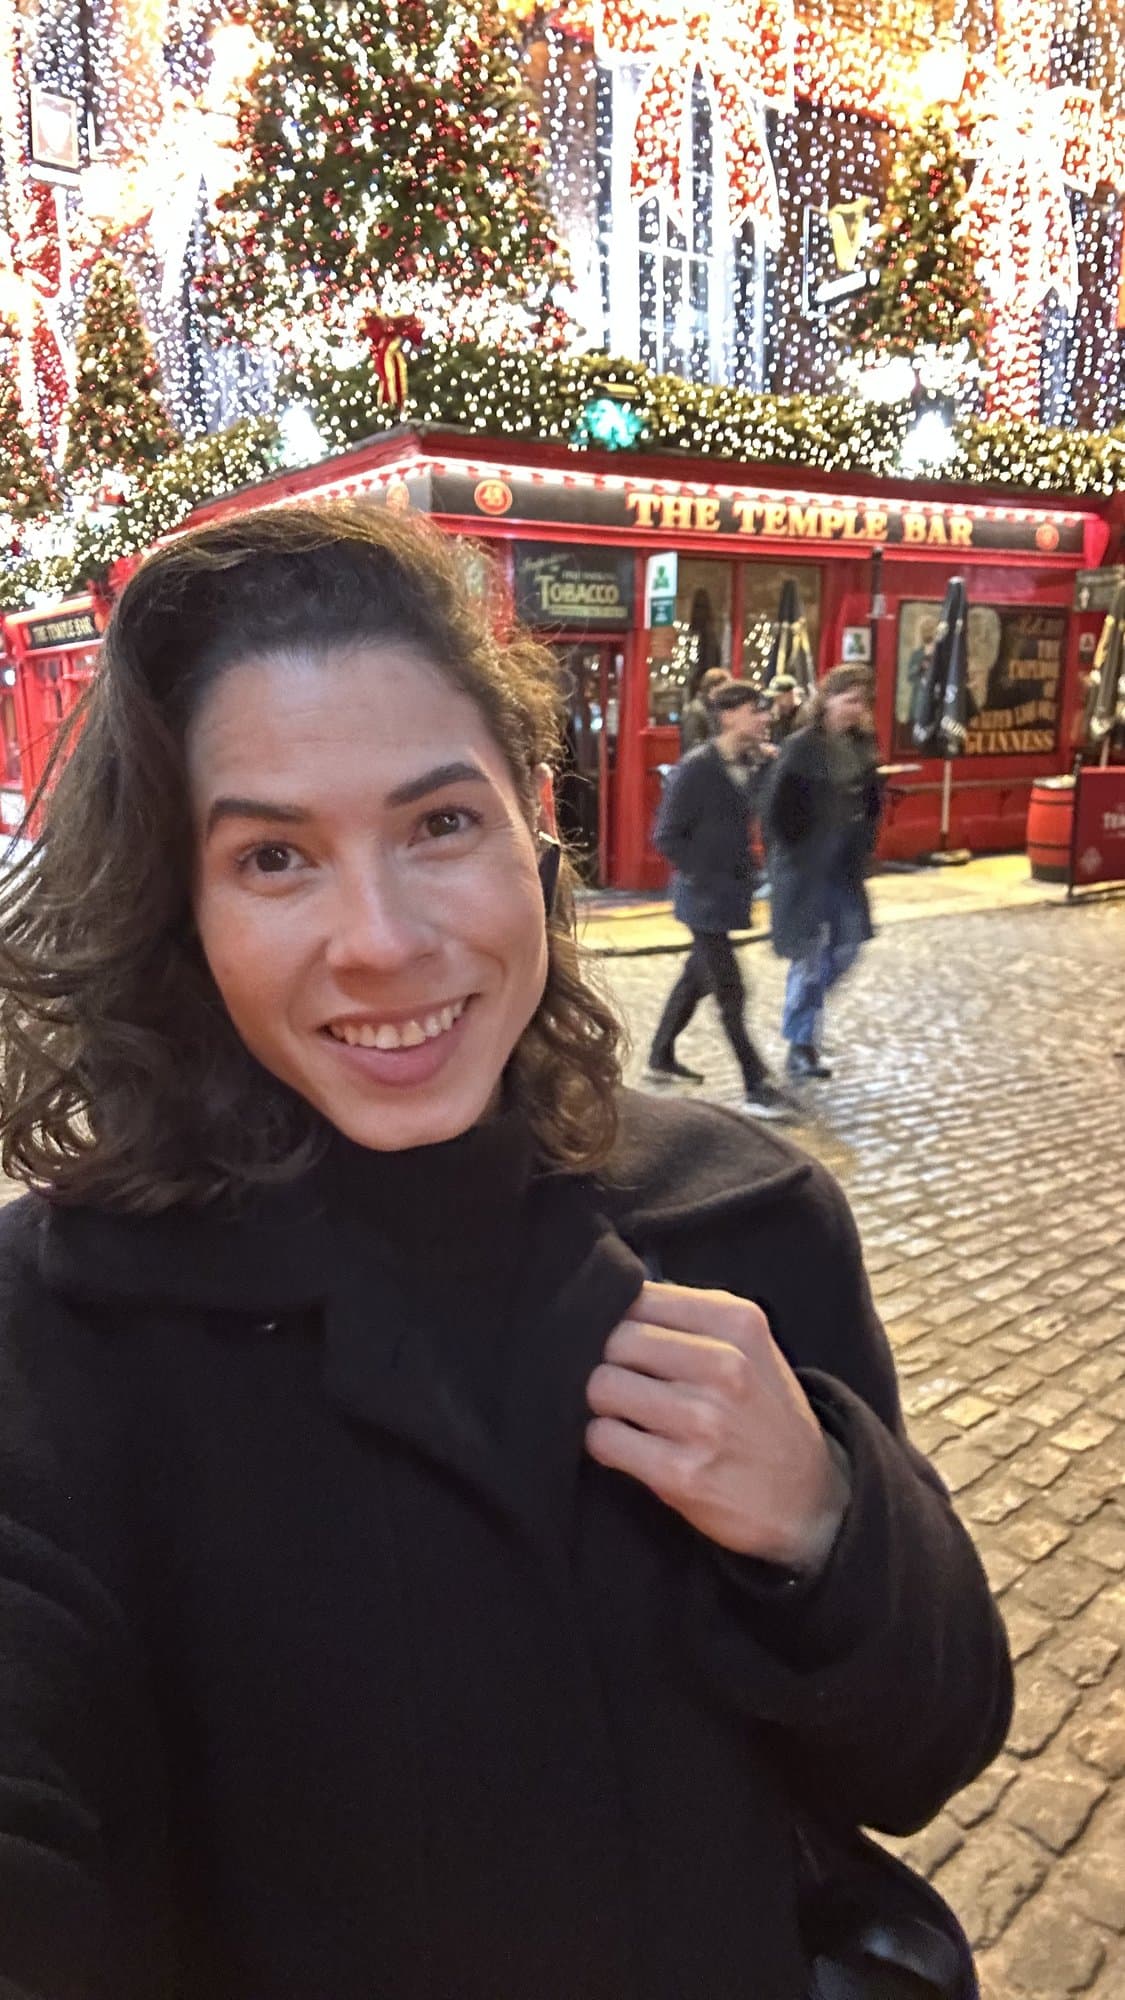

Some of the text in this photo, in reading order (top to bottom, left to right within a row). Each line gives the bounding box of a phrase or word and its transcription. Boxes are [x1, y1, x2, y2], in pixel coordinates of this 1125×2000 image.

[627, 493, 974, 546] THE TEMPLE BAR
[534, 574, 620, 611] TOBACCO
[965, 729, 1055, 754] GUINNESS
